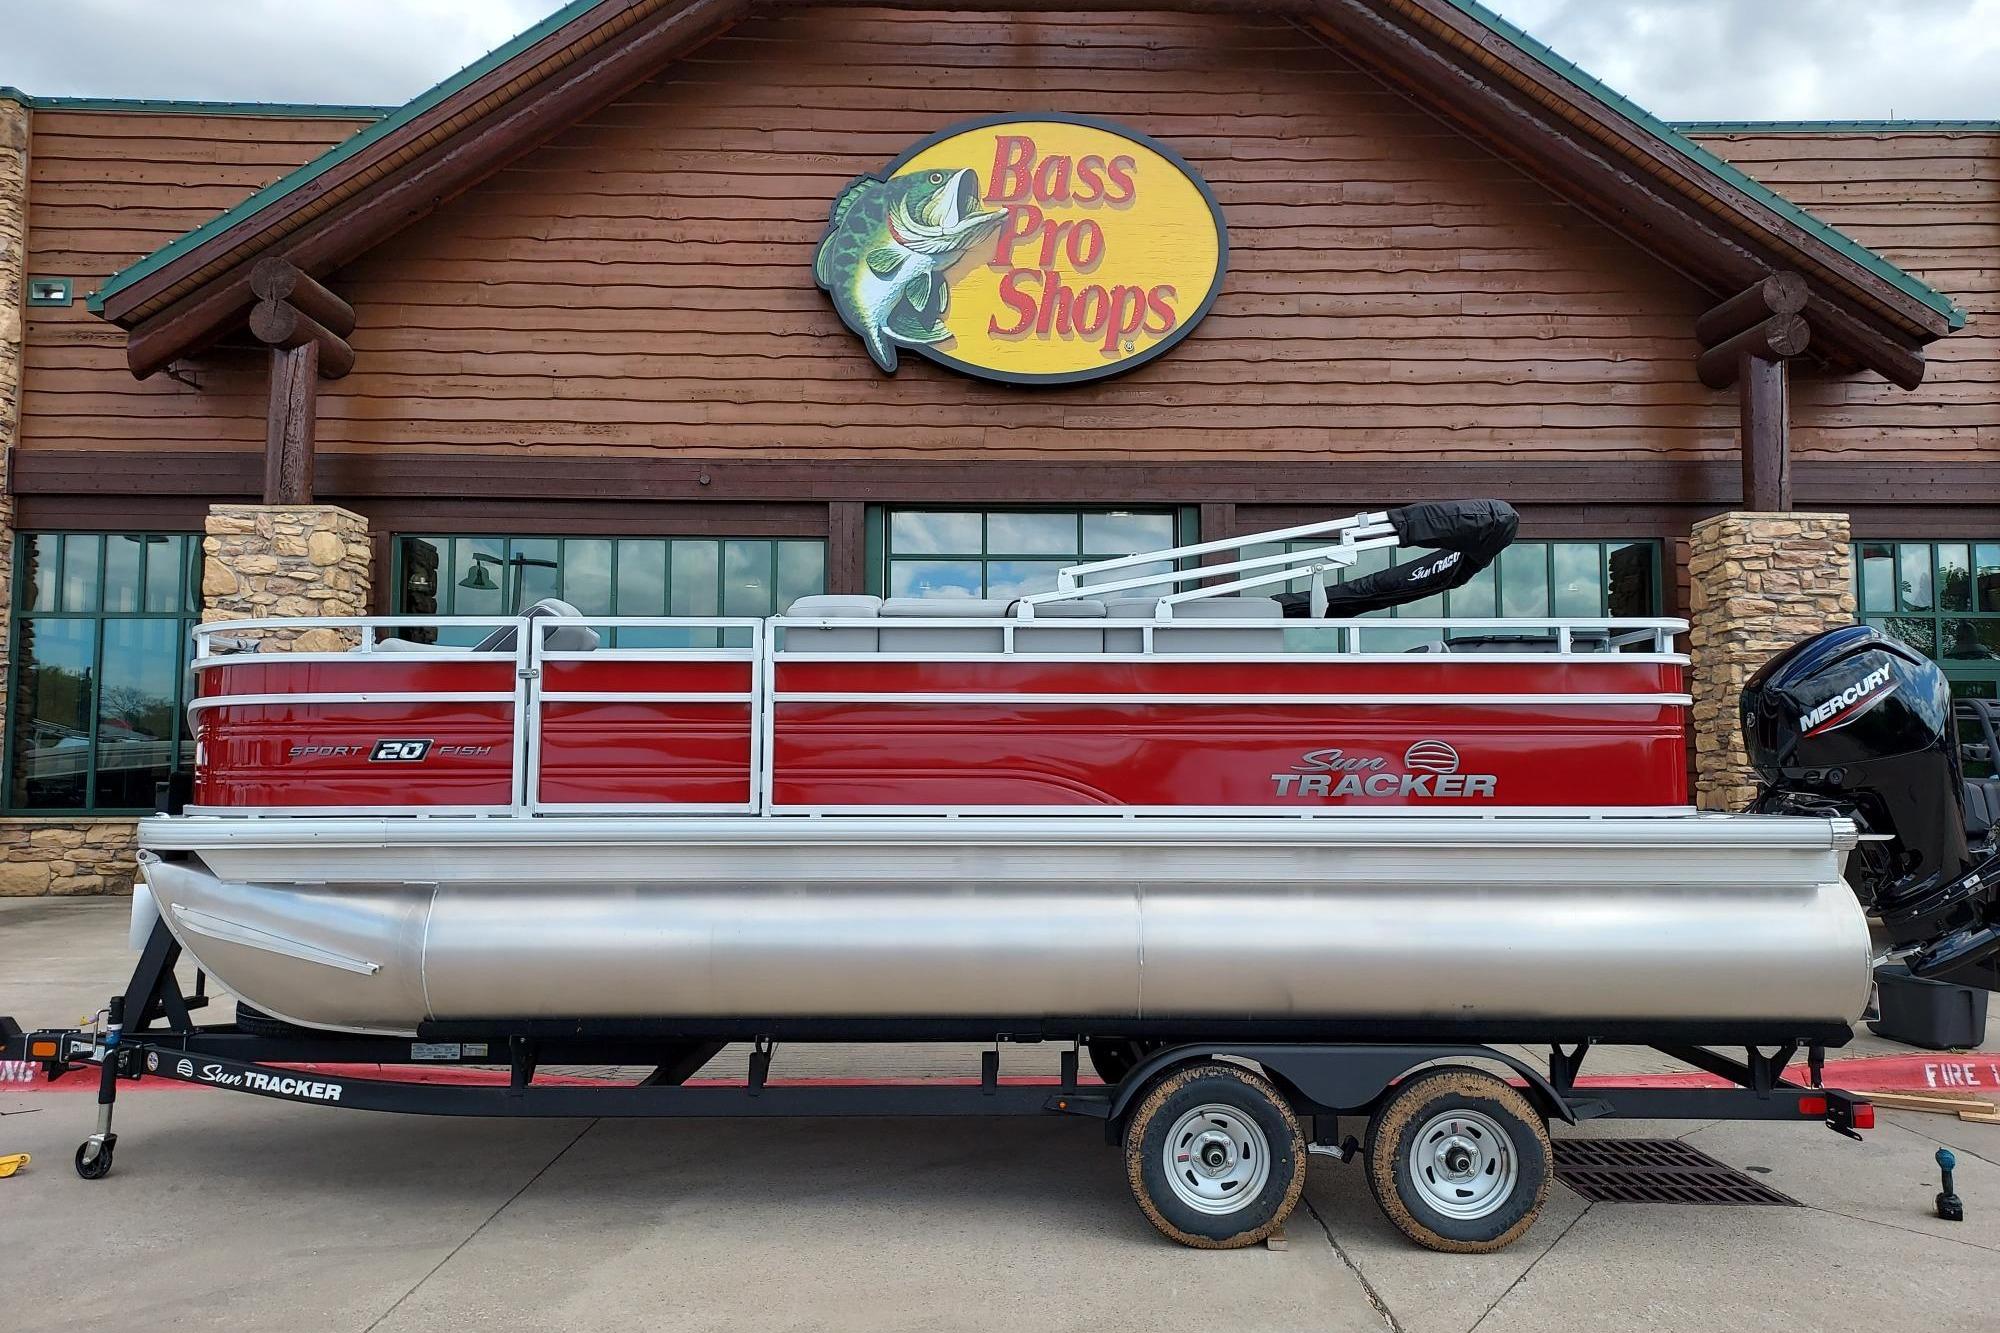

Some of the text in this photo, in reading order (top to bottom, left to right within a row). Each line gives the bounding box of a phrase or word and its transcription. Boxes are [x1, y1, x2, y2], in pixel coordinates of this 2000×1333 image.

[983, 134, 1137, 204] Bass
[986, 204, 1104, 268] Pro
[987, 268, 1178, 352] Shops
[1799, 662, 1891, 732] MERCURY
[288, 742, 492, 760] SPORT 20 FISH
[1290, 749, 1388, 772] Sun
[1271, 773, 1498, 798] TRACKER
[198, 1064, 342, 1101] Sun TRACKER
[1924, 1063, 1981, 1088] FIRE
